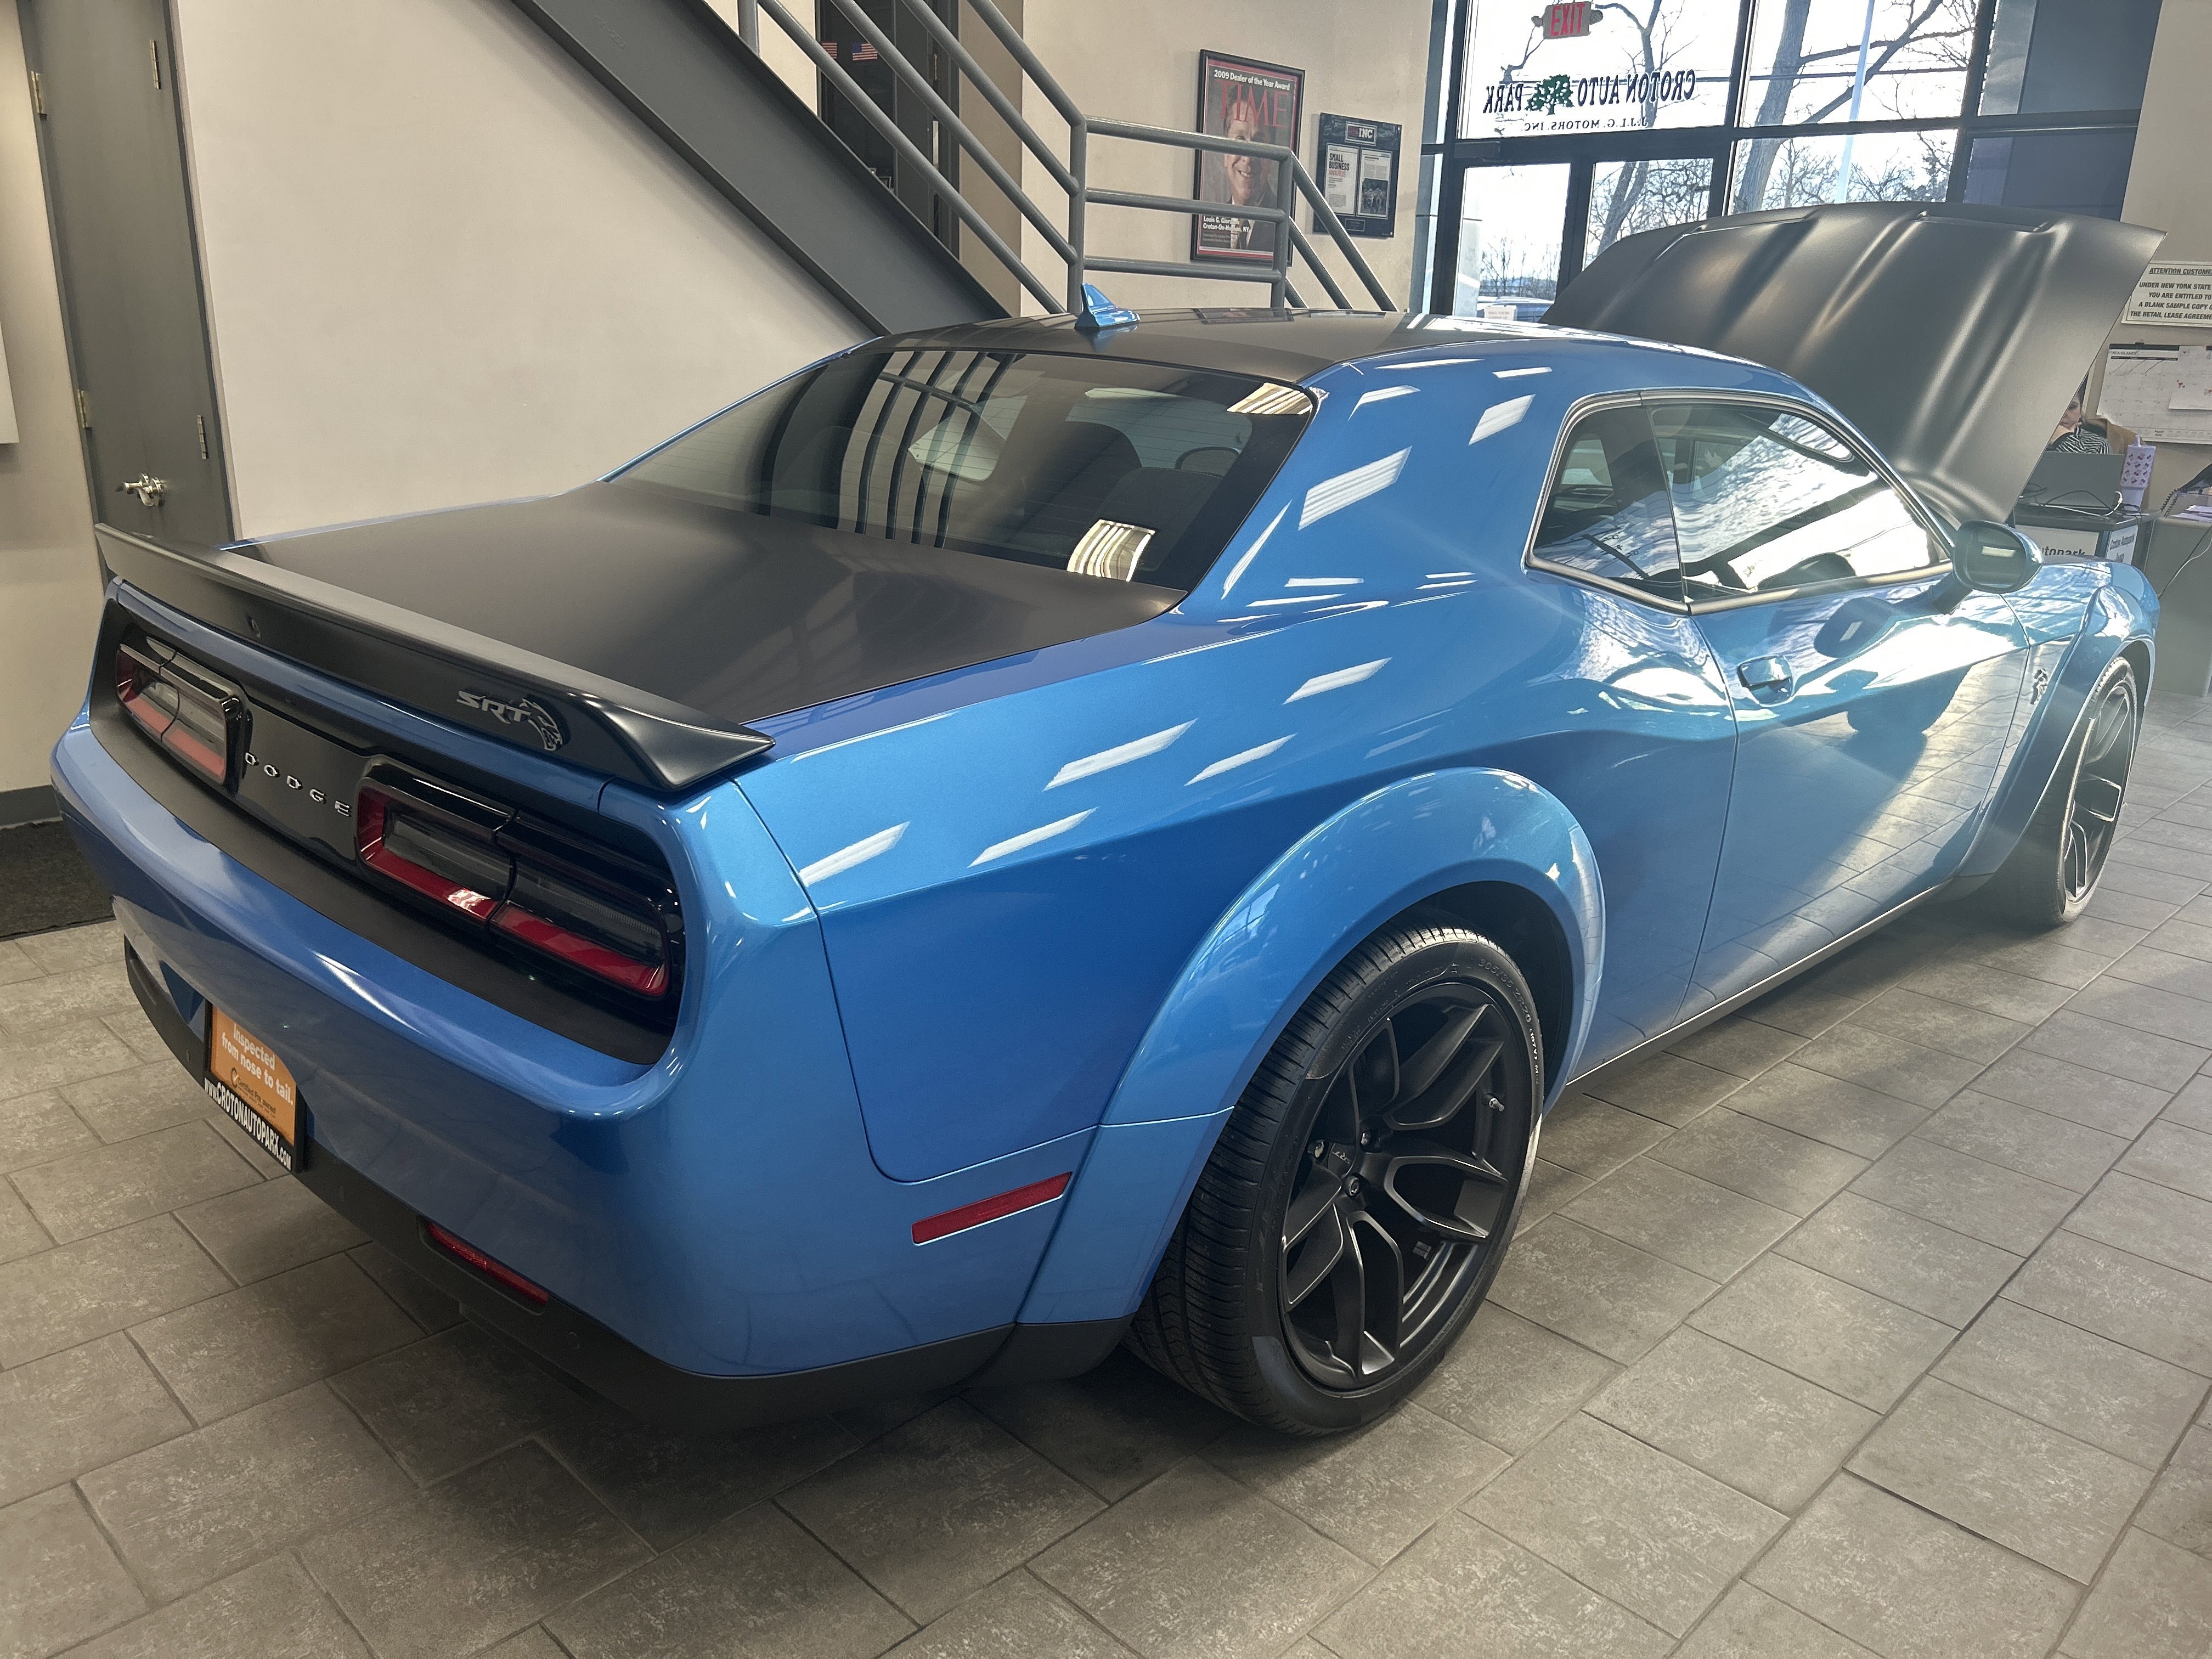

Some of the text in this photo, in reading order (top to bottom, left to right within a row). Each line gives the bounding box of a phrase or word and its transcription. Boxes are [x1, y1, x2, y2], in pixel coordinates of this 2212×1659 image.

[1550, 3, 1585, 36] EXIT
[1214, 70, 1290, 91] 2009 Dealer of the Year Award
[1214, 79, 1289, 128] TIME
[1358, 128, 1373, 139] INC
[1329, 153, 1344, 162] SMALL
[1329, 161, 1350, 171] BUSINESS
[456, 691, 532, 724] SRT
[245, 752, 351, 817] DODGE
[234, 1023, 275, 1070] Inspected
[222, 1032, 239, 1061] from
[240, 1053, 262, 1079] nose
[263, 1069, 274, 1088] to
[276, 1079, 293, 1105] tail.
